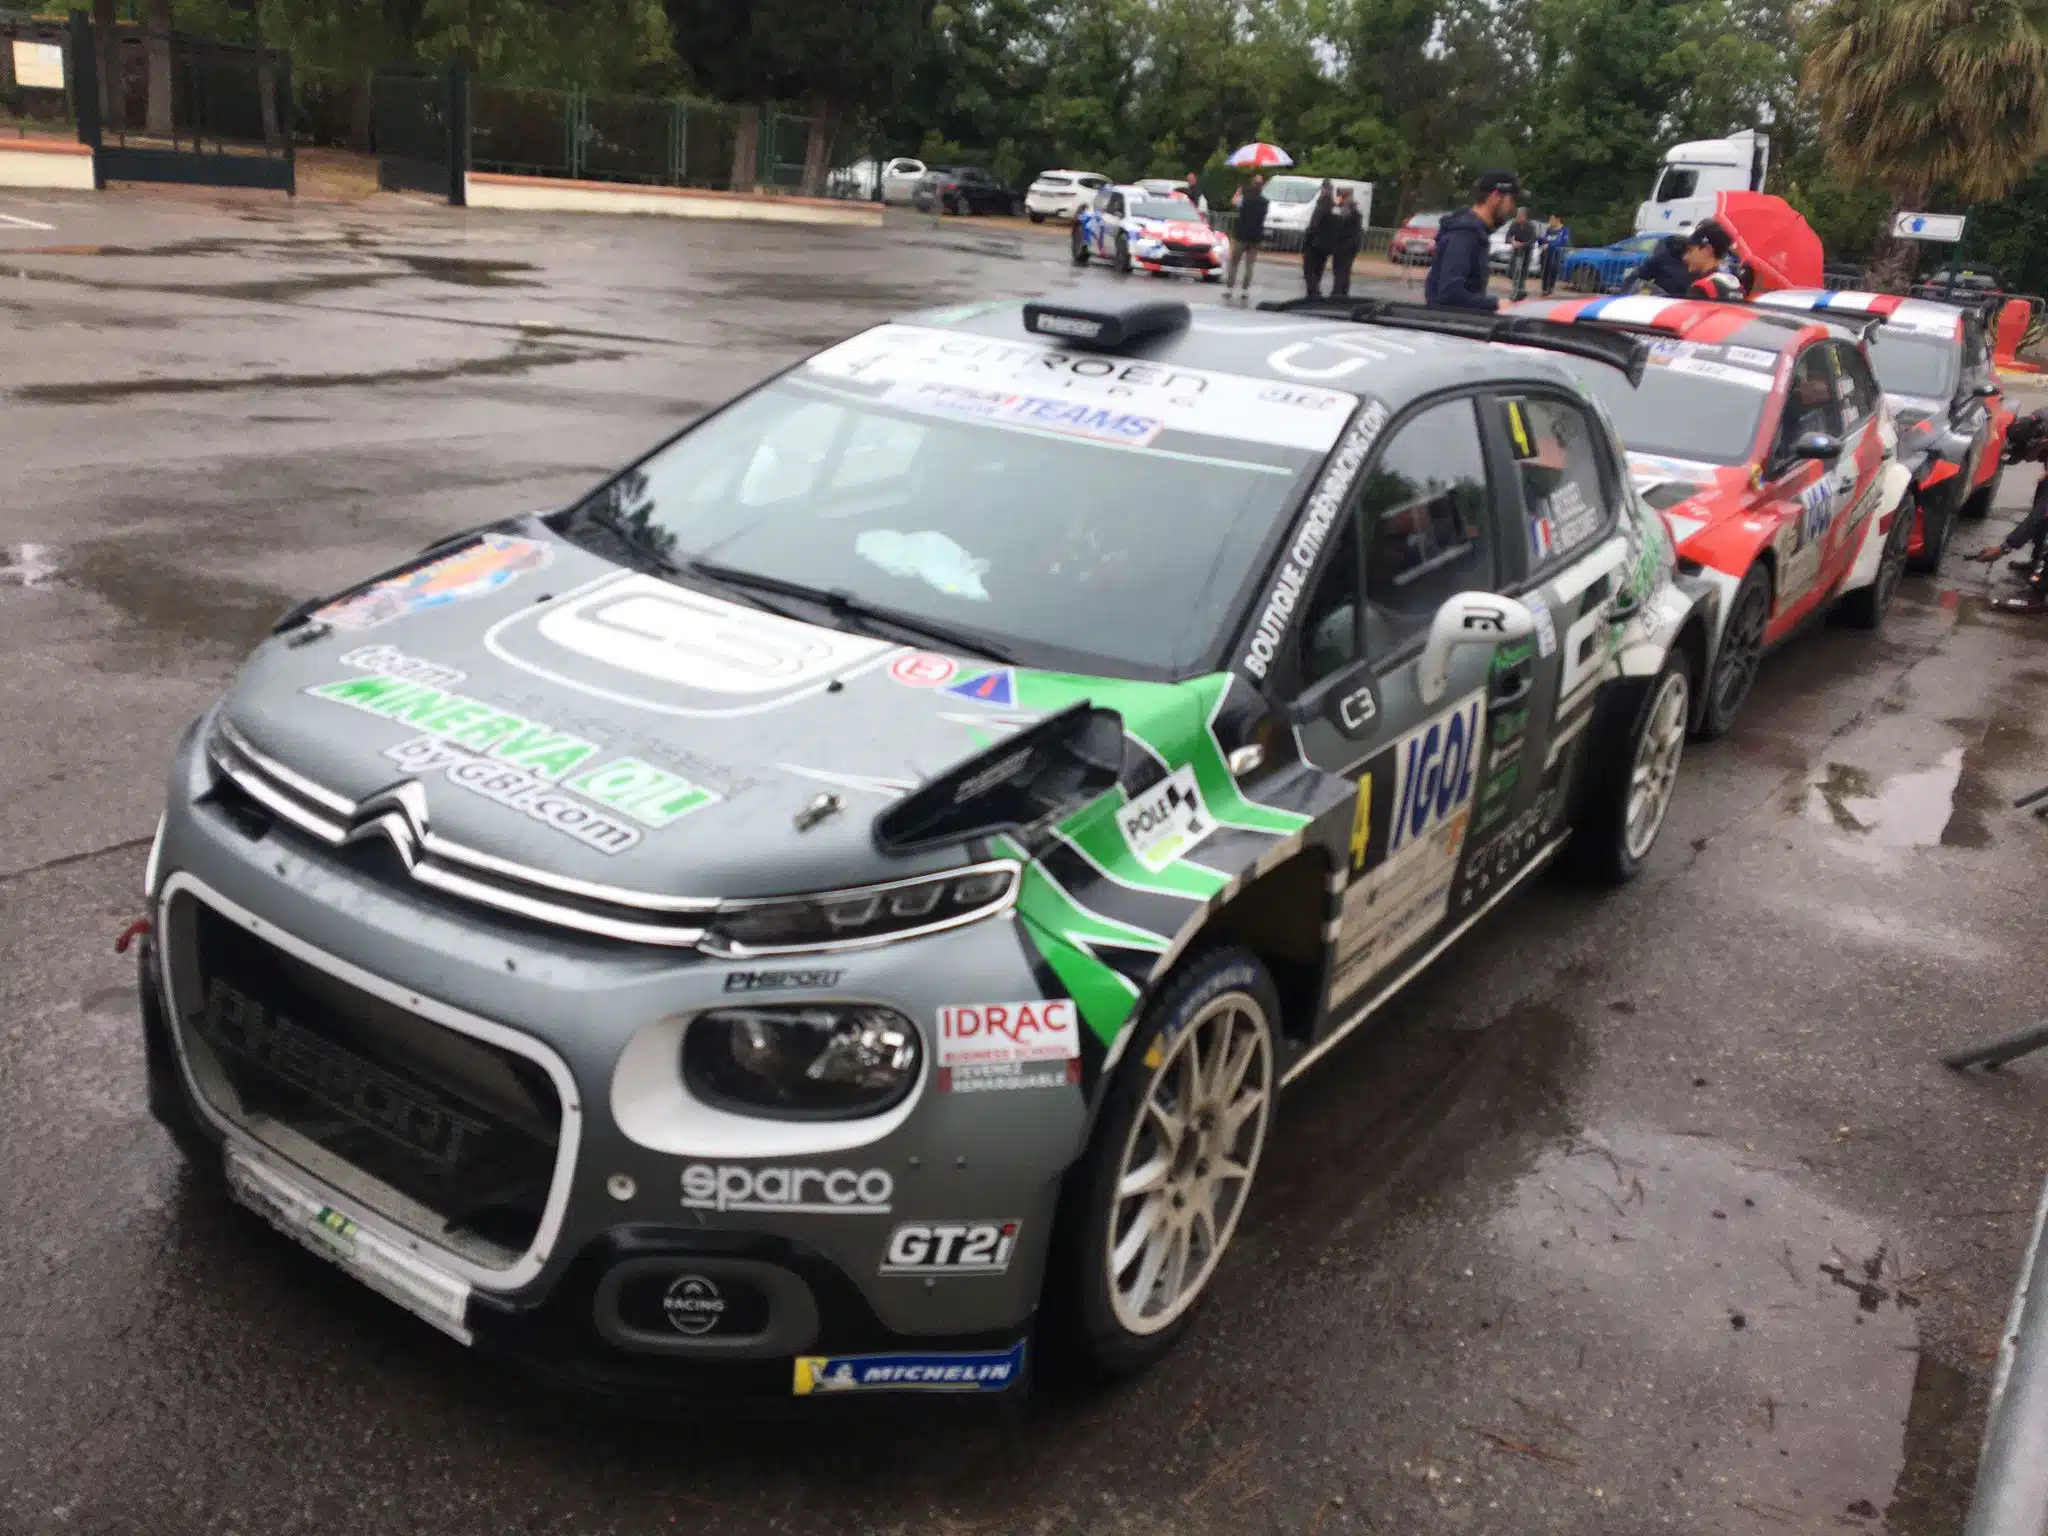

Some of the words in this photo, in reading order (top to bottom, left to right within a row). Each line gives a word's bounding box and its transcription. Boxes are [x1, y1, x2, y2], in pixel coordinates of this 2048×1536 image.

[1013, 396, 1160, 439] TEAMS
[308, 673, 594, 782] MINERVA
[1340, 686, 1377, 731] C3
[1393, 701, 1479, 853] IGOL
[943, 1003, 1069, 1042] IDRAC
[680, 1163, 894, 1212] sparco
[888, 1223, 1017, 1266] GT2i
[863, 1362, 1012, 1383] MICHELIN
